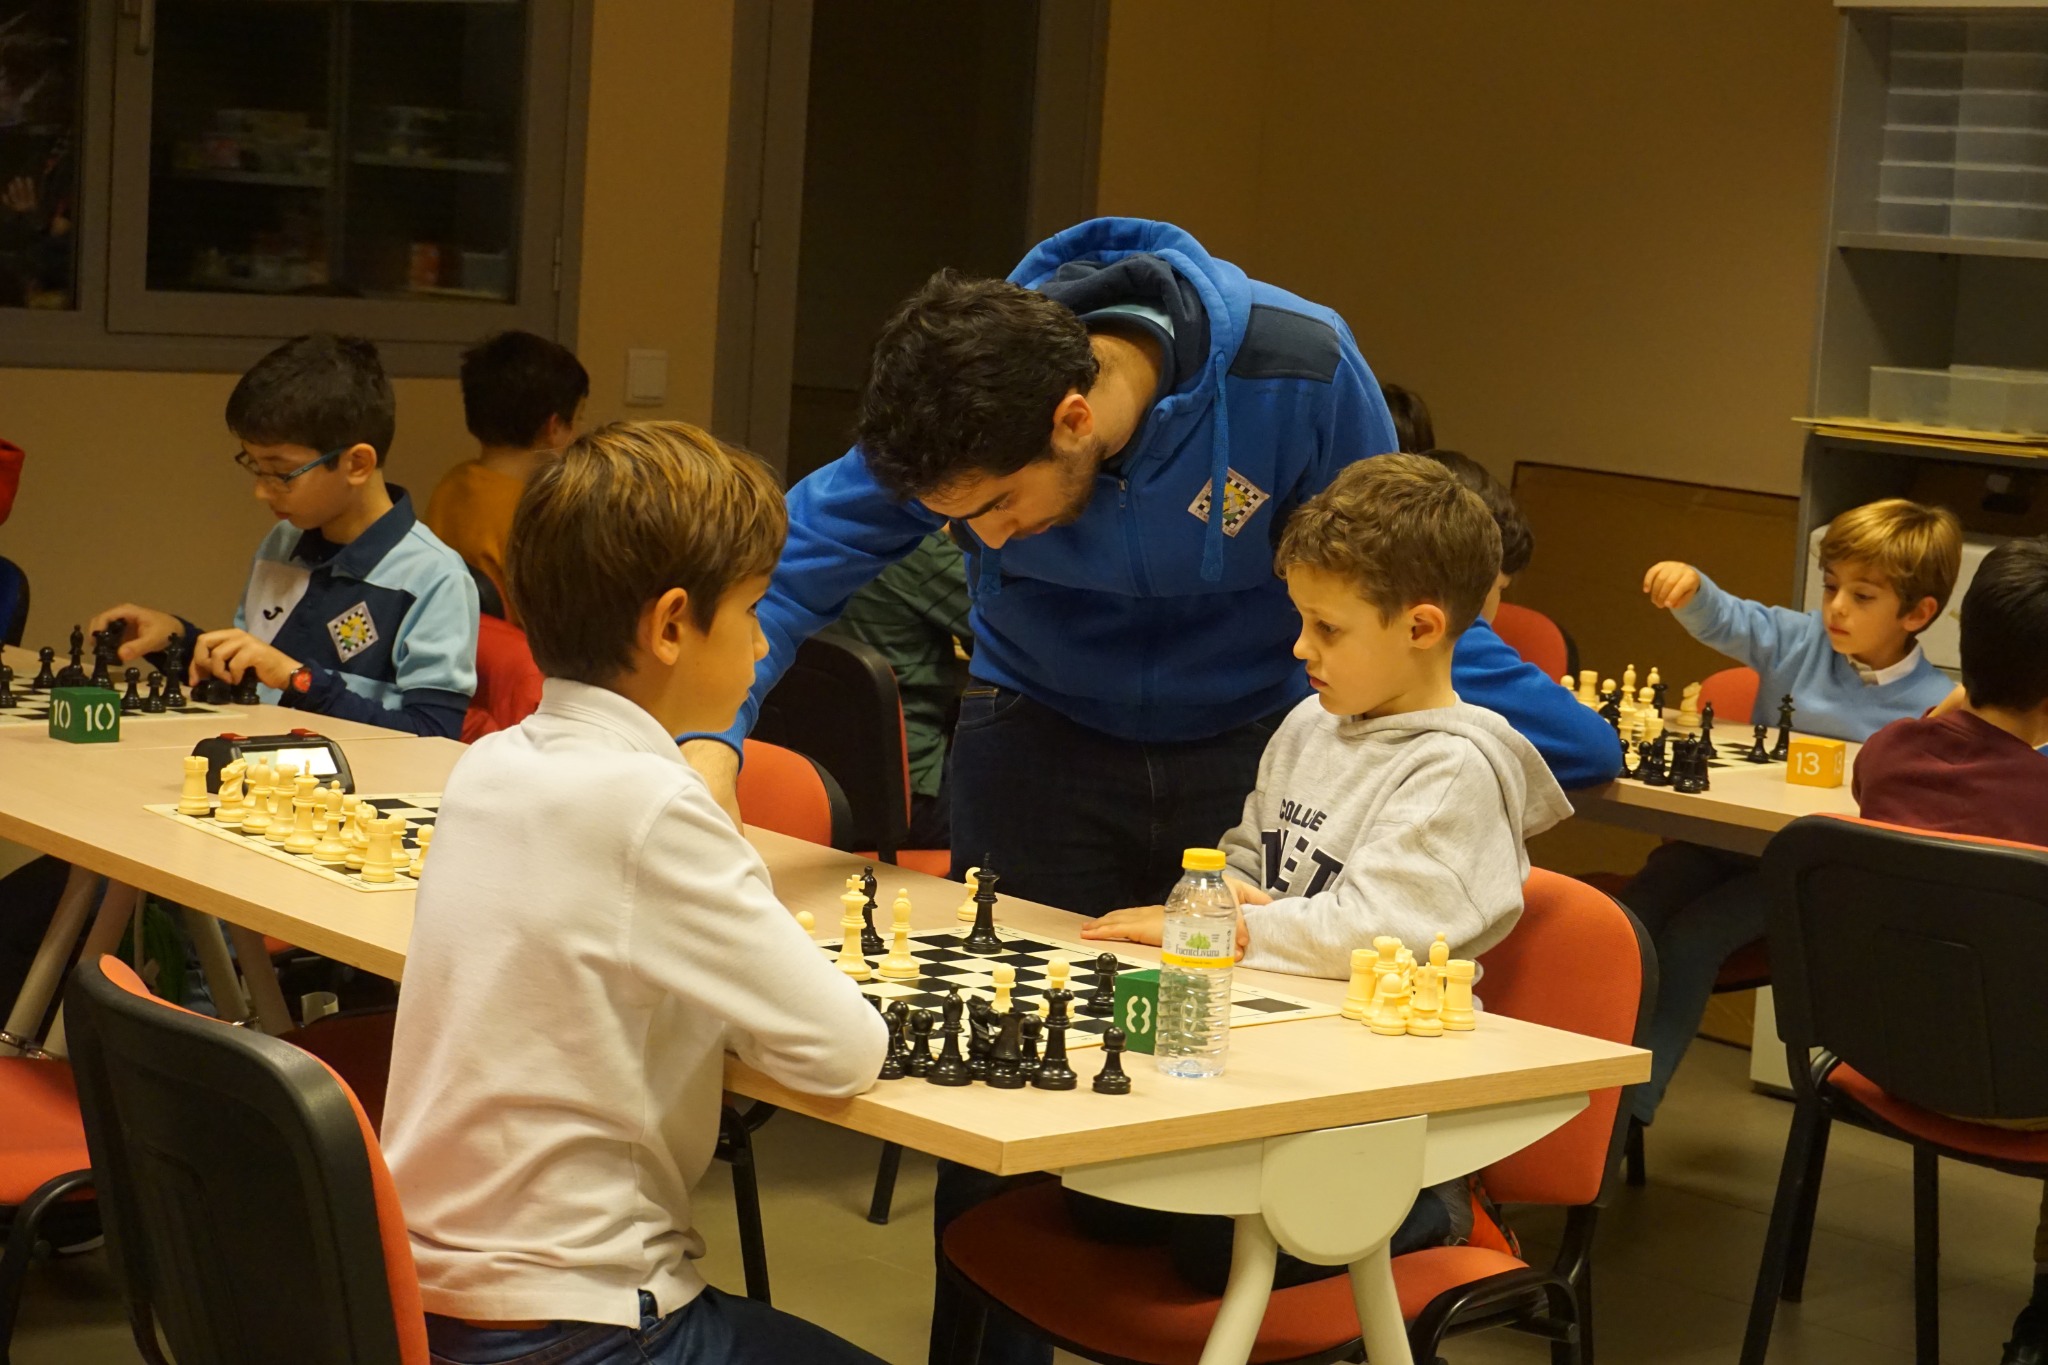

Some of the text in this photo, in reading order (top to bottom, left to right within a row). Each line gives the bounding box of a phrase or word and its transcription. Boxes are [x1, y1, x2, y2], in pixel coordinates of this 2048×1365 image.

[53, 699, 71, 729] 10
[84, 702, 115, 732] 10
[1796, 751, 1820, 775] 13
[1126, 995, 1152, 1034] 8
